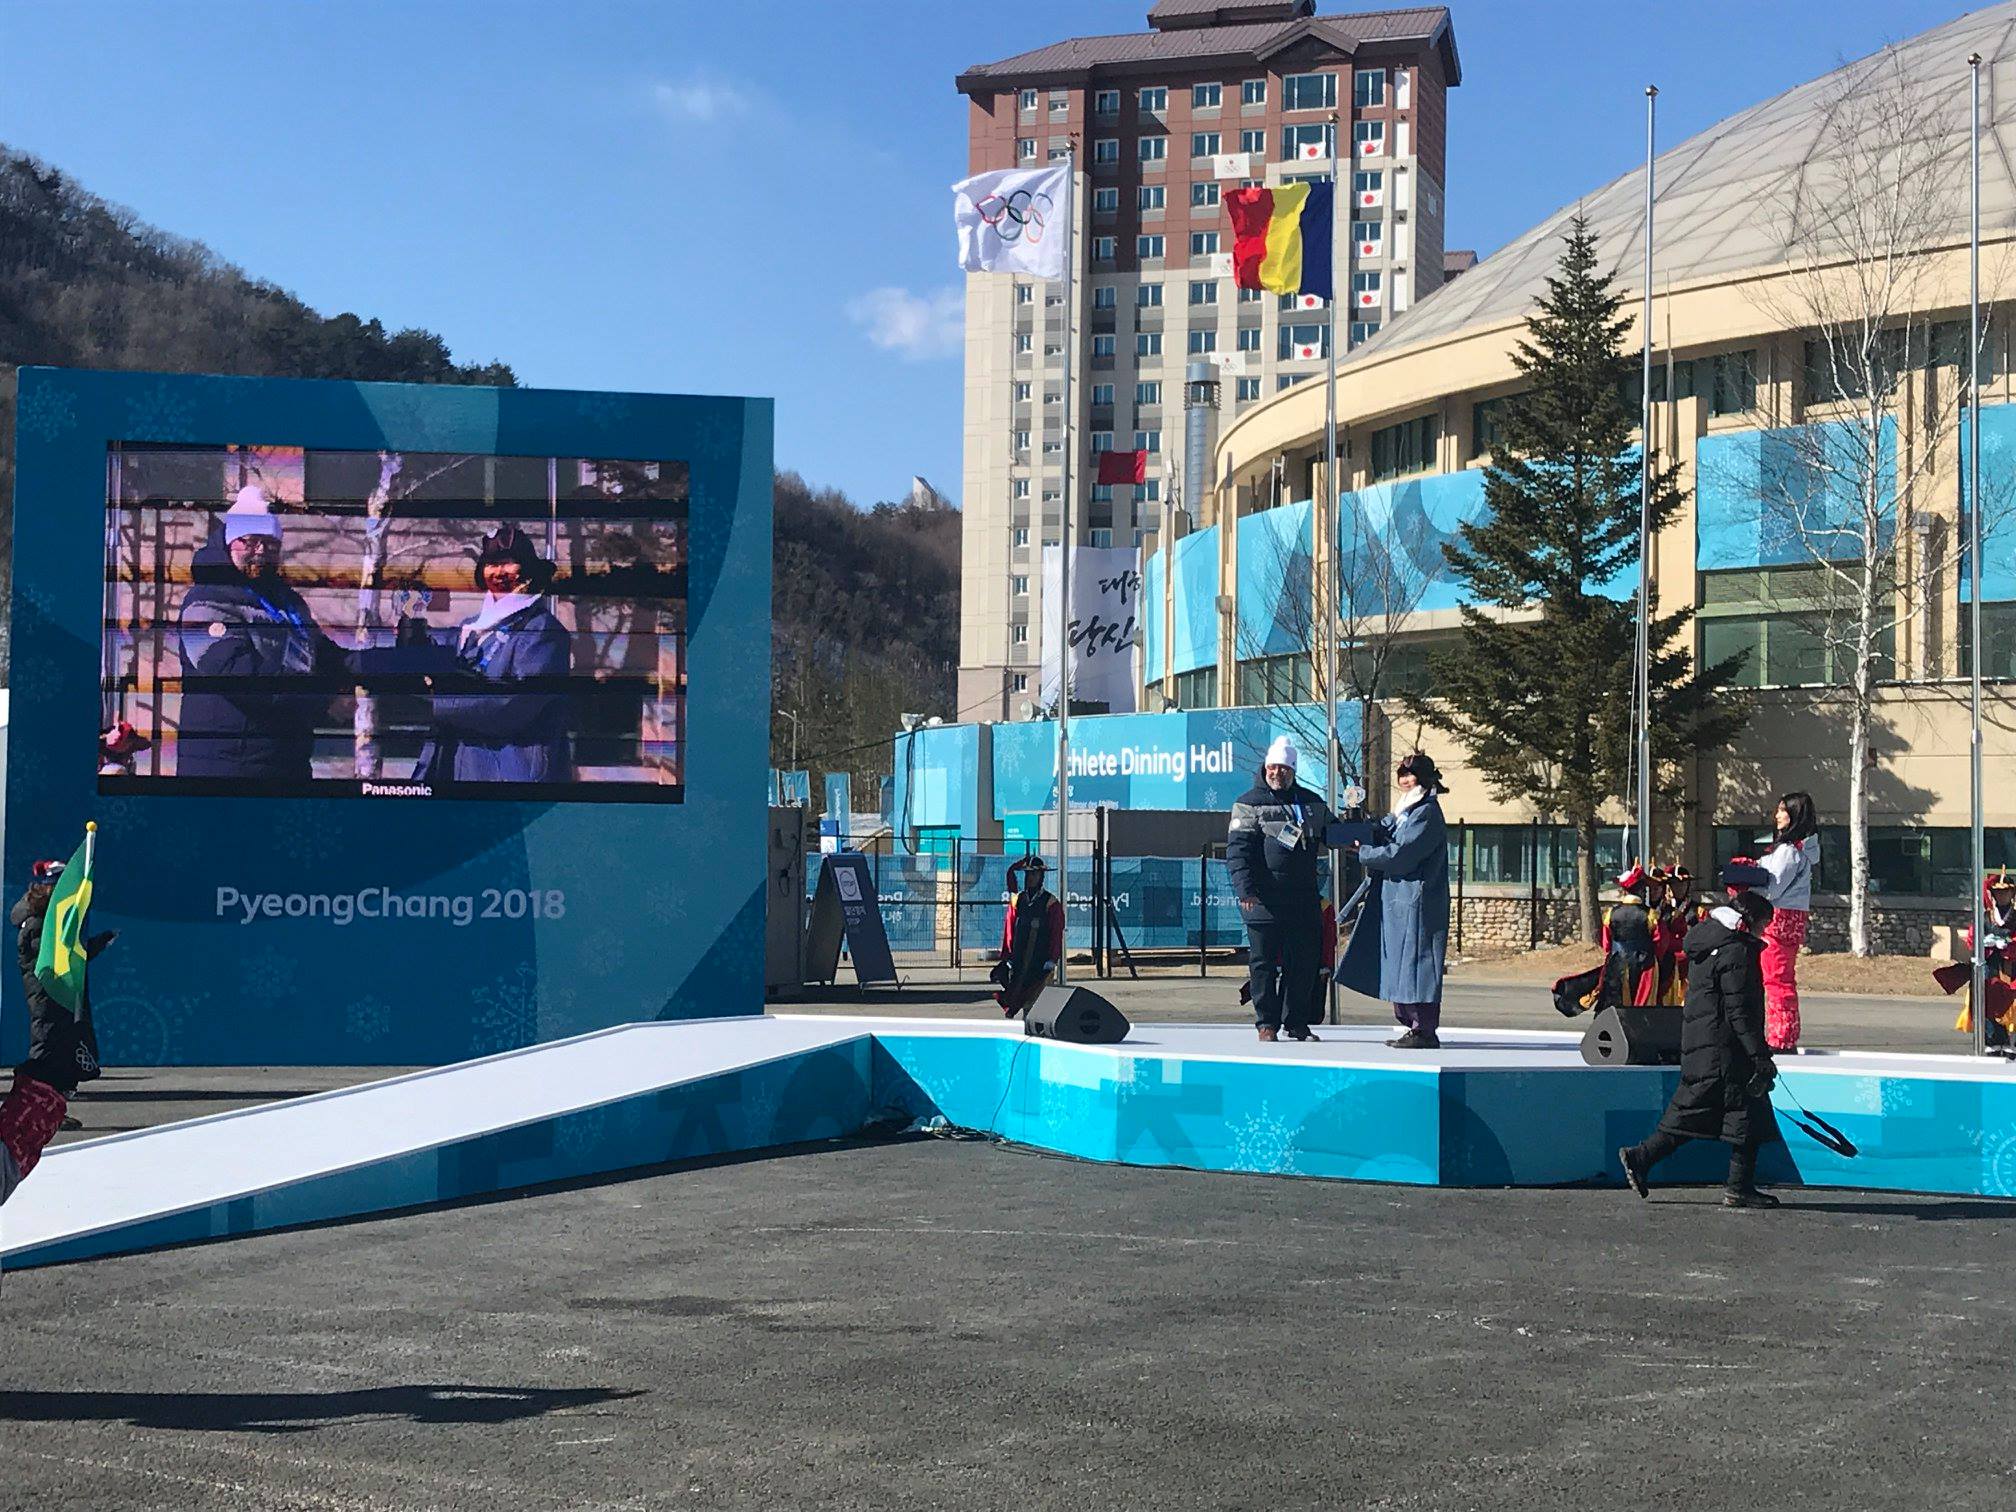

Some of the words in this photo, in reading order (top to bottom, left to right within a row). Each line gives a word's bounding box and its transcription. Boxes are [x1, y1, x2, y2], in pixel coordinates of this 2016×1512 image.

[1053, 747, 1118, 778] Ahlete
[1121, 745, 1187, 783] Dining
[1190, 741, 1234, 773] Hall
[361, 782, 434, 797] Panasonic
[216, 886, 474, 927] PyeongChang
[480, 888, 567, 919] 2018
